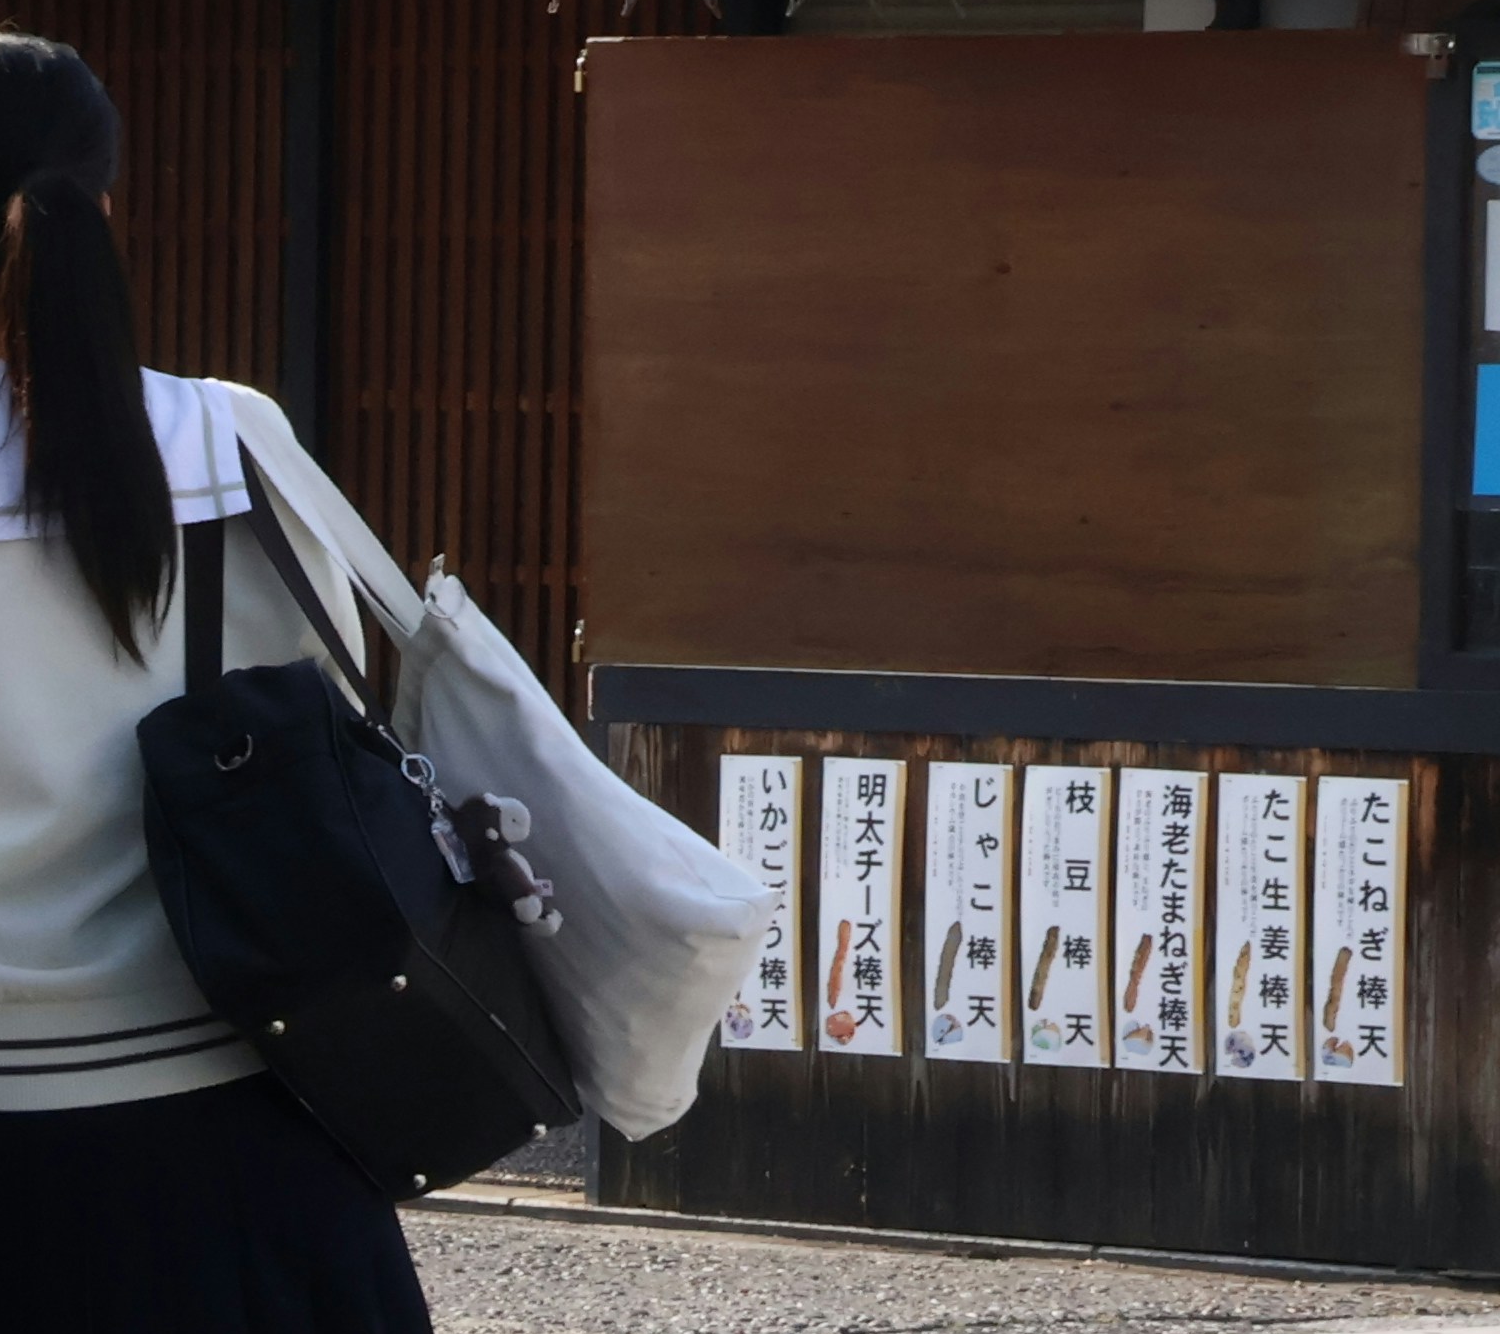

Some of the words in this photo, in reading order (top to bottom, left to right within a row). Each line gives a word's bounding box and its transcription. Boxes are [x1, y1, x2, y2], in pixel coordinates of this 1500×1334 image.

[759, 767, 788, 1029] いかごう棒天
[853, 773, 887, 1028] 明太チーズ棒天
[966, 777, 1000, 1028] じゃこ棒天
[1062, 780, 1096, 1046] 枝豆棒天
[1157, 784, 1193, 1068] 海老たまねぎ棒天
[1258, 789, 1291, 1058] たこ生姜棒天
[1356, 791, 1390, 1059] たこねぎ棒天
